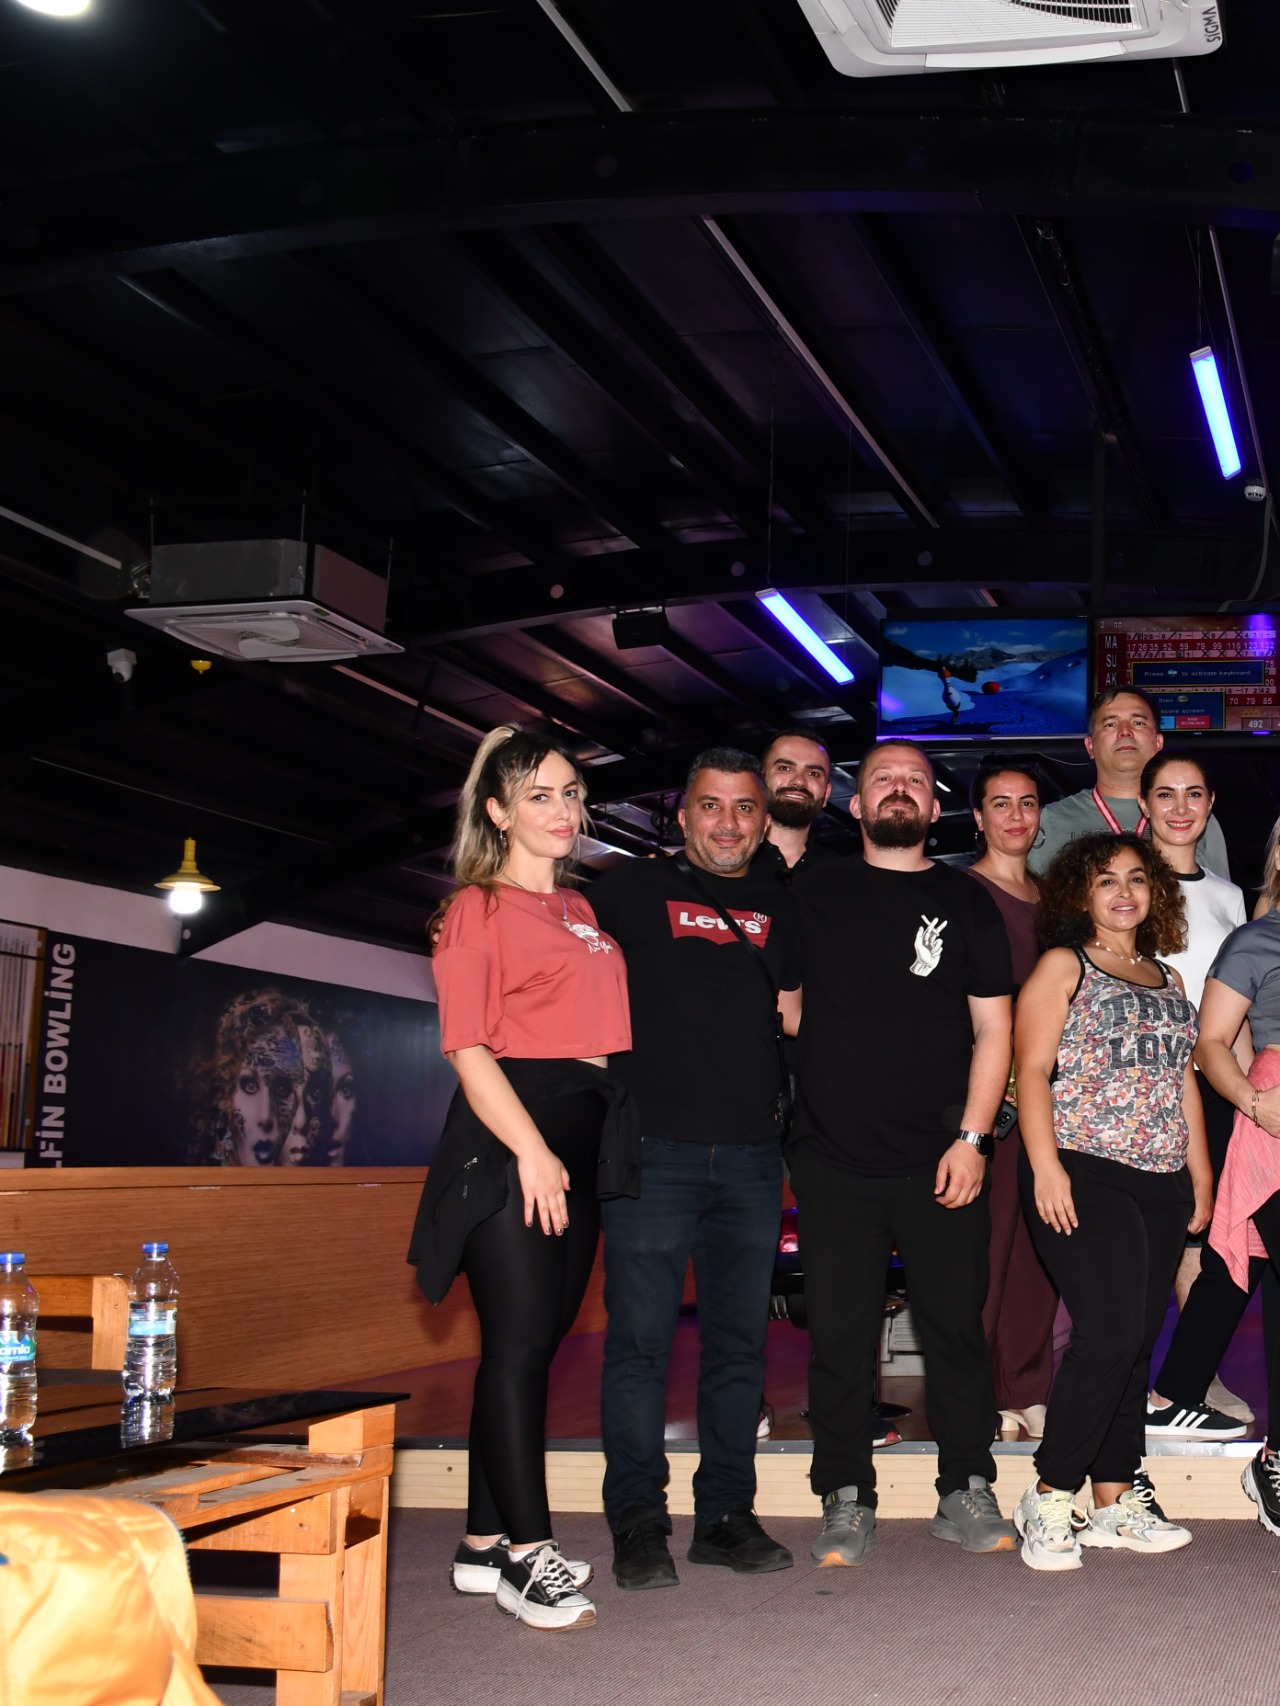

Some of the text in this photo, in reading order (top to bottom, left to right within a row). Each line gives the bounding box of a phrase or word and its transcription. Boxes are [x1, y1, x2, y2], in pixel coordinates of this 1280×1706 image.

[1105, 636, 1117, 648] MA
[1106, 654, 1117, 667] SU
[1105, 672, 1117, 686] AK
[1248, 720, 1263, 728] 492
[1099, 991, 1199, 1028] TRU
